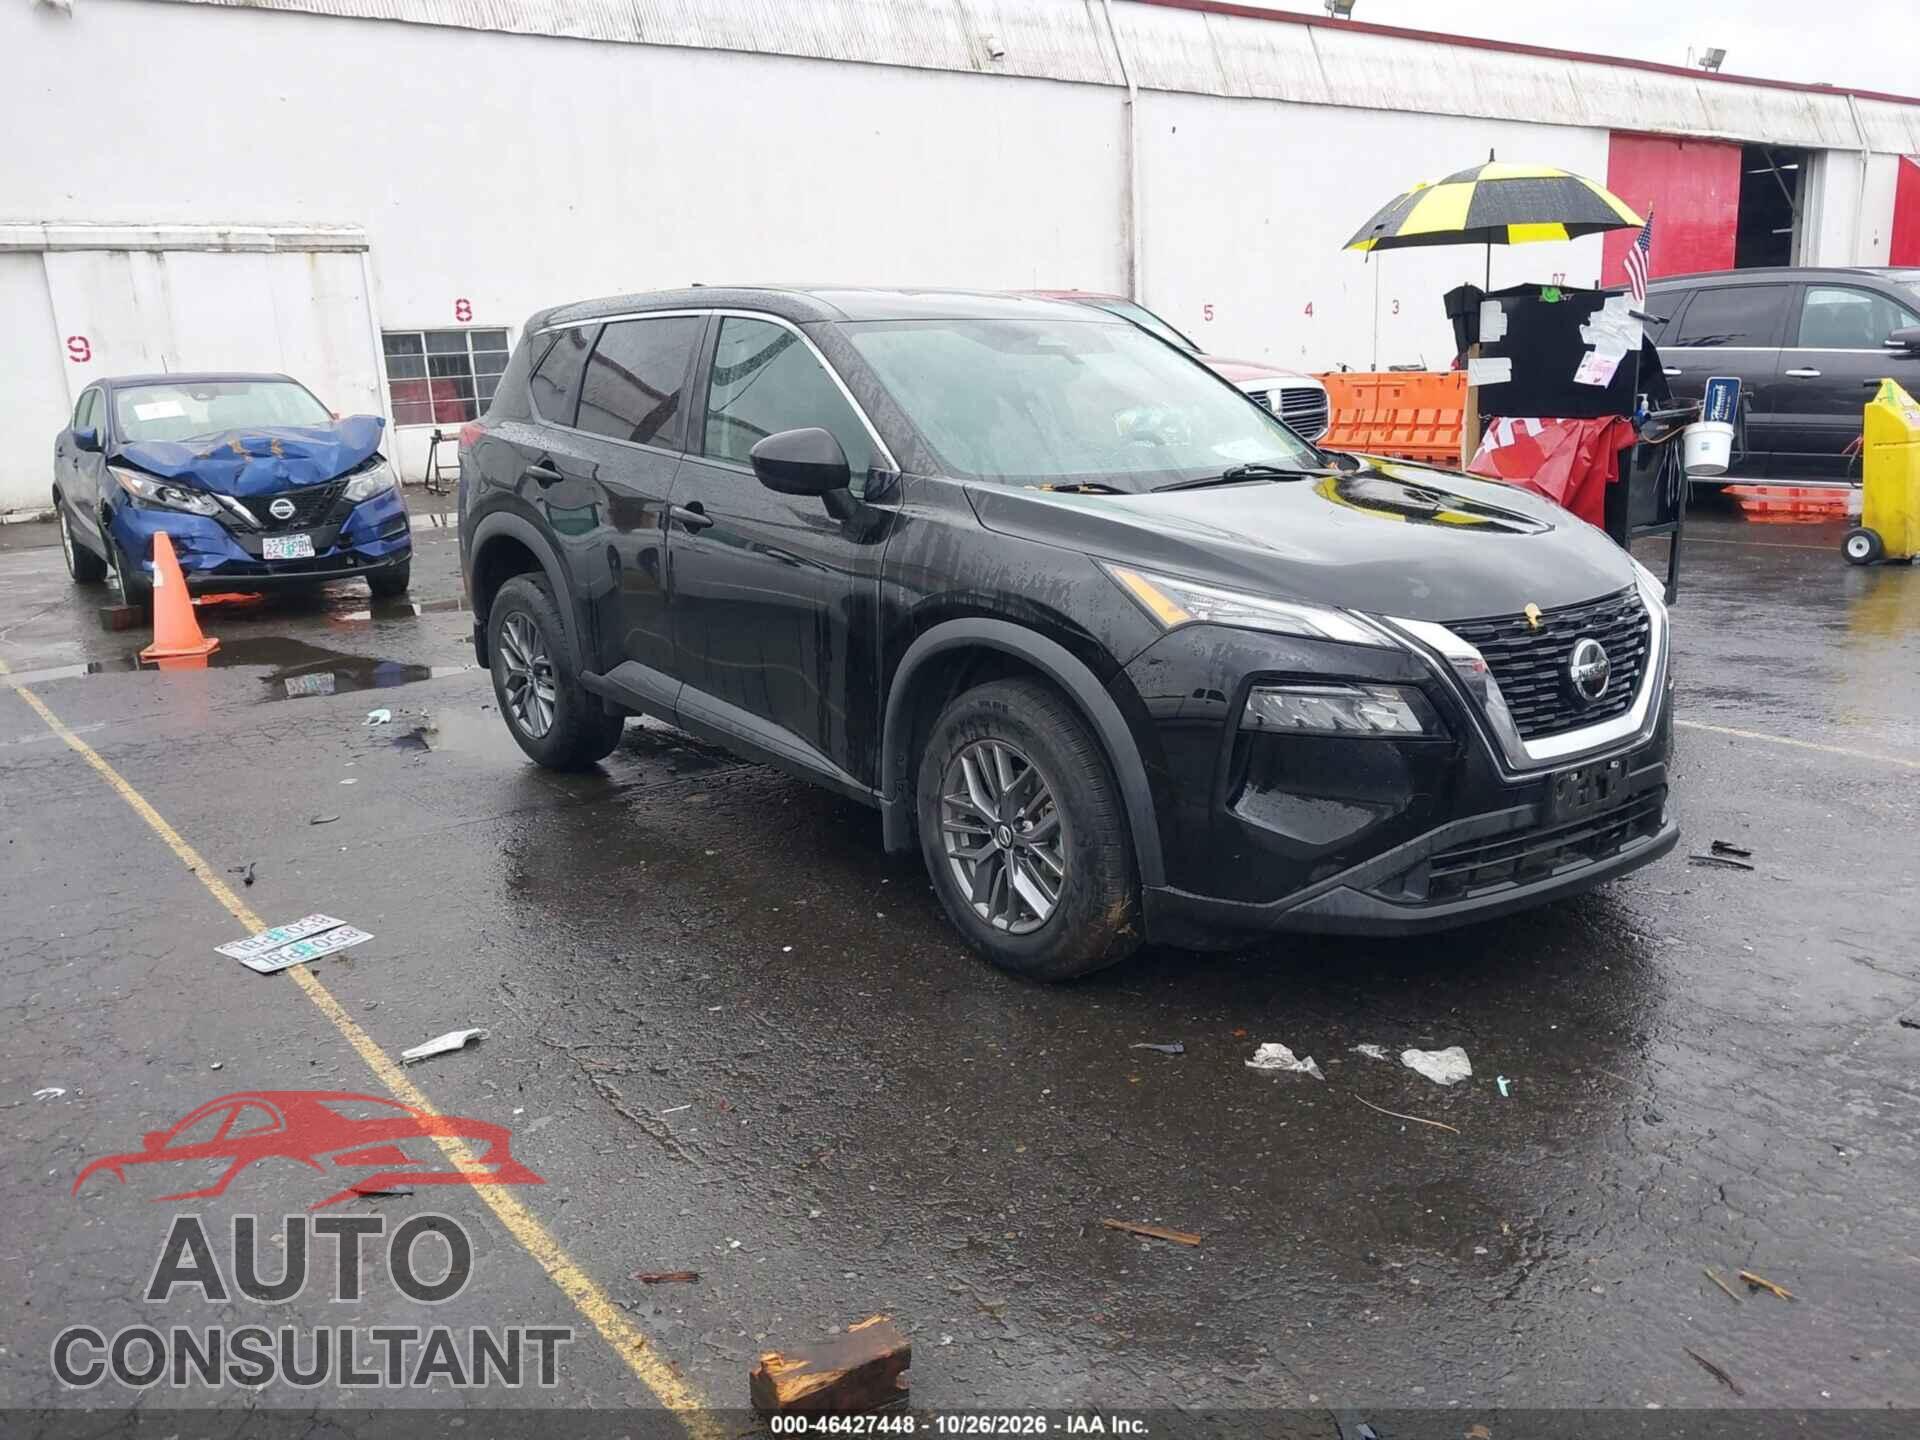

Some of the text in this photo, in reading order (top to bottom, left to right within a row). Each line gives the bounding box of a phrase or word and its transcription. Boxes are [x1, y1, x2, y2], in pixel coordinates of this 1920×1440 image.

[456, 299, 472, 322] 8
[1203, 304, 1214, 322] 5
[1304, 301, 1314, 318] 4
[1392, 299, 1400, 315] 3
[67, 336, 91, 363] 9
